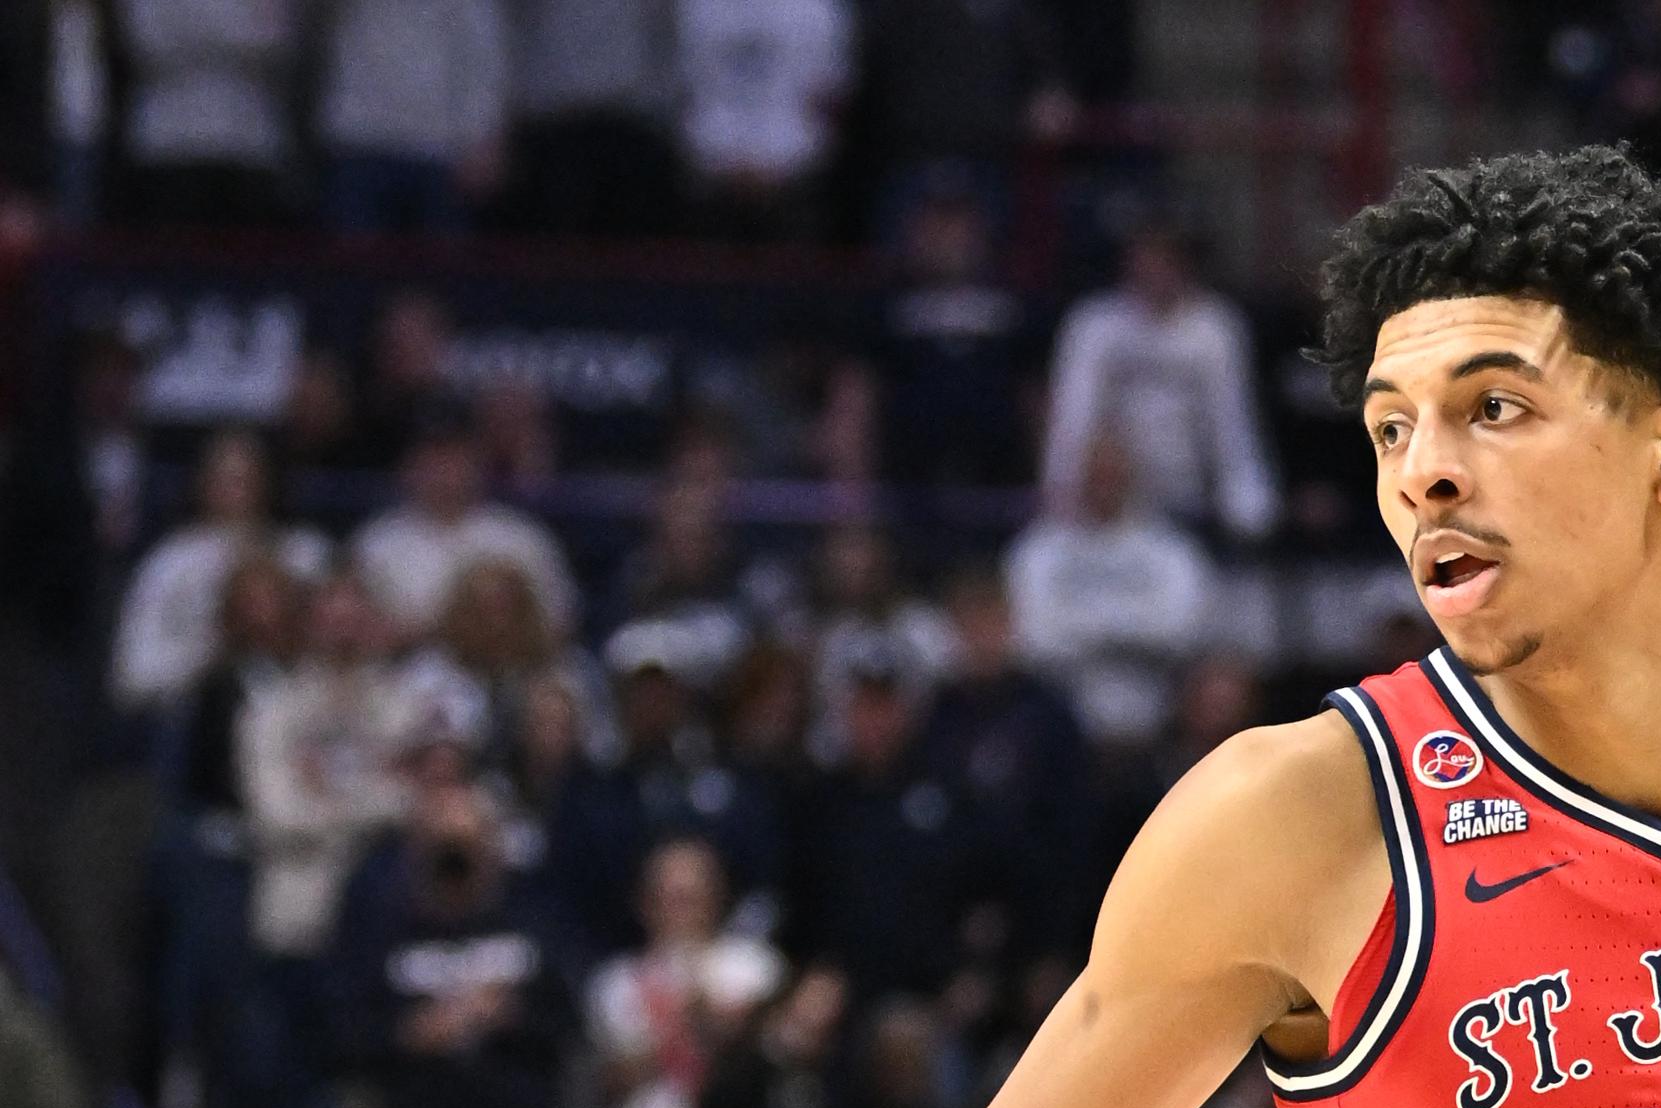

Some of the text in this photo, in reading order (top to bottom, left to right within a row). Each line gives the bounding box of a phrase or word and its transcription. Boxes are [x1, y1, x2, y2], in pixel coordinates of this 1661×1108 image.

[1448, 799, 1521, 822] BE THE
[1443, 811, 1527, 843] CHANGE
